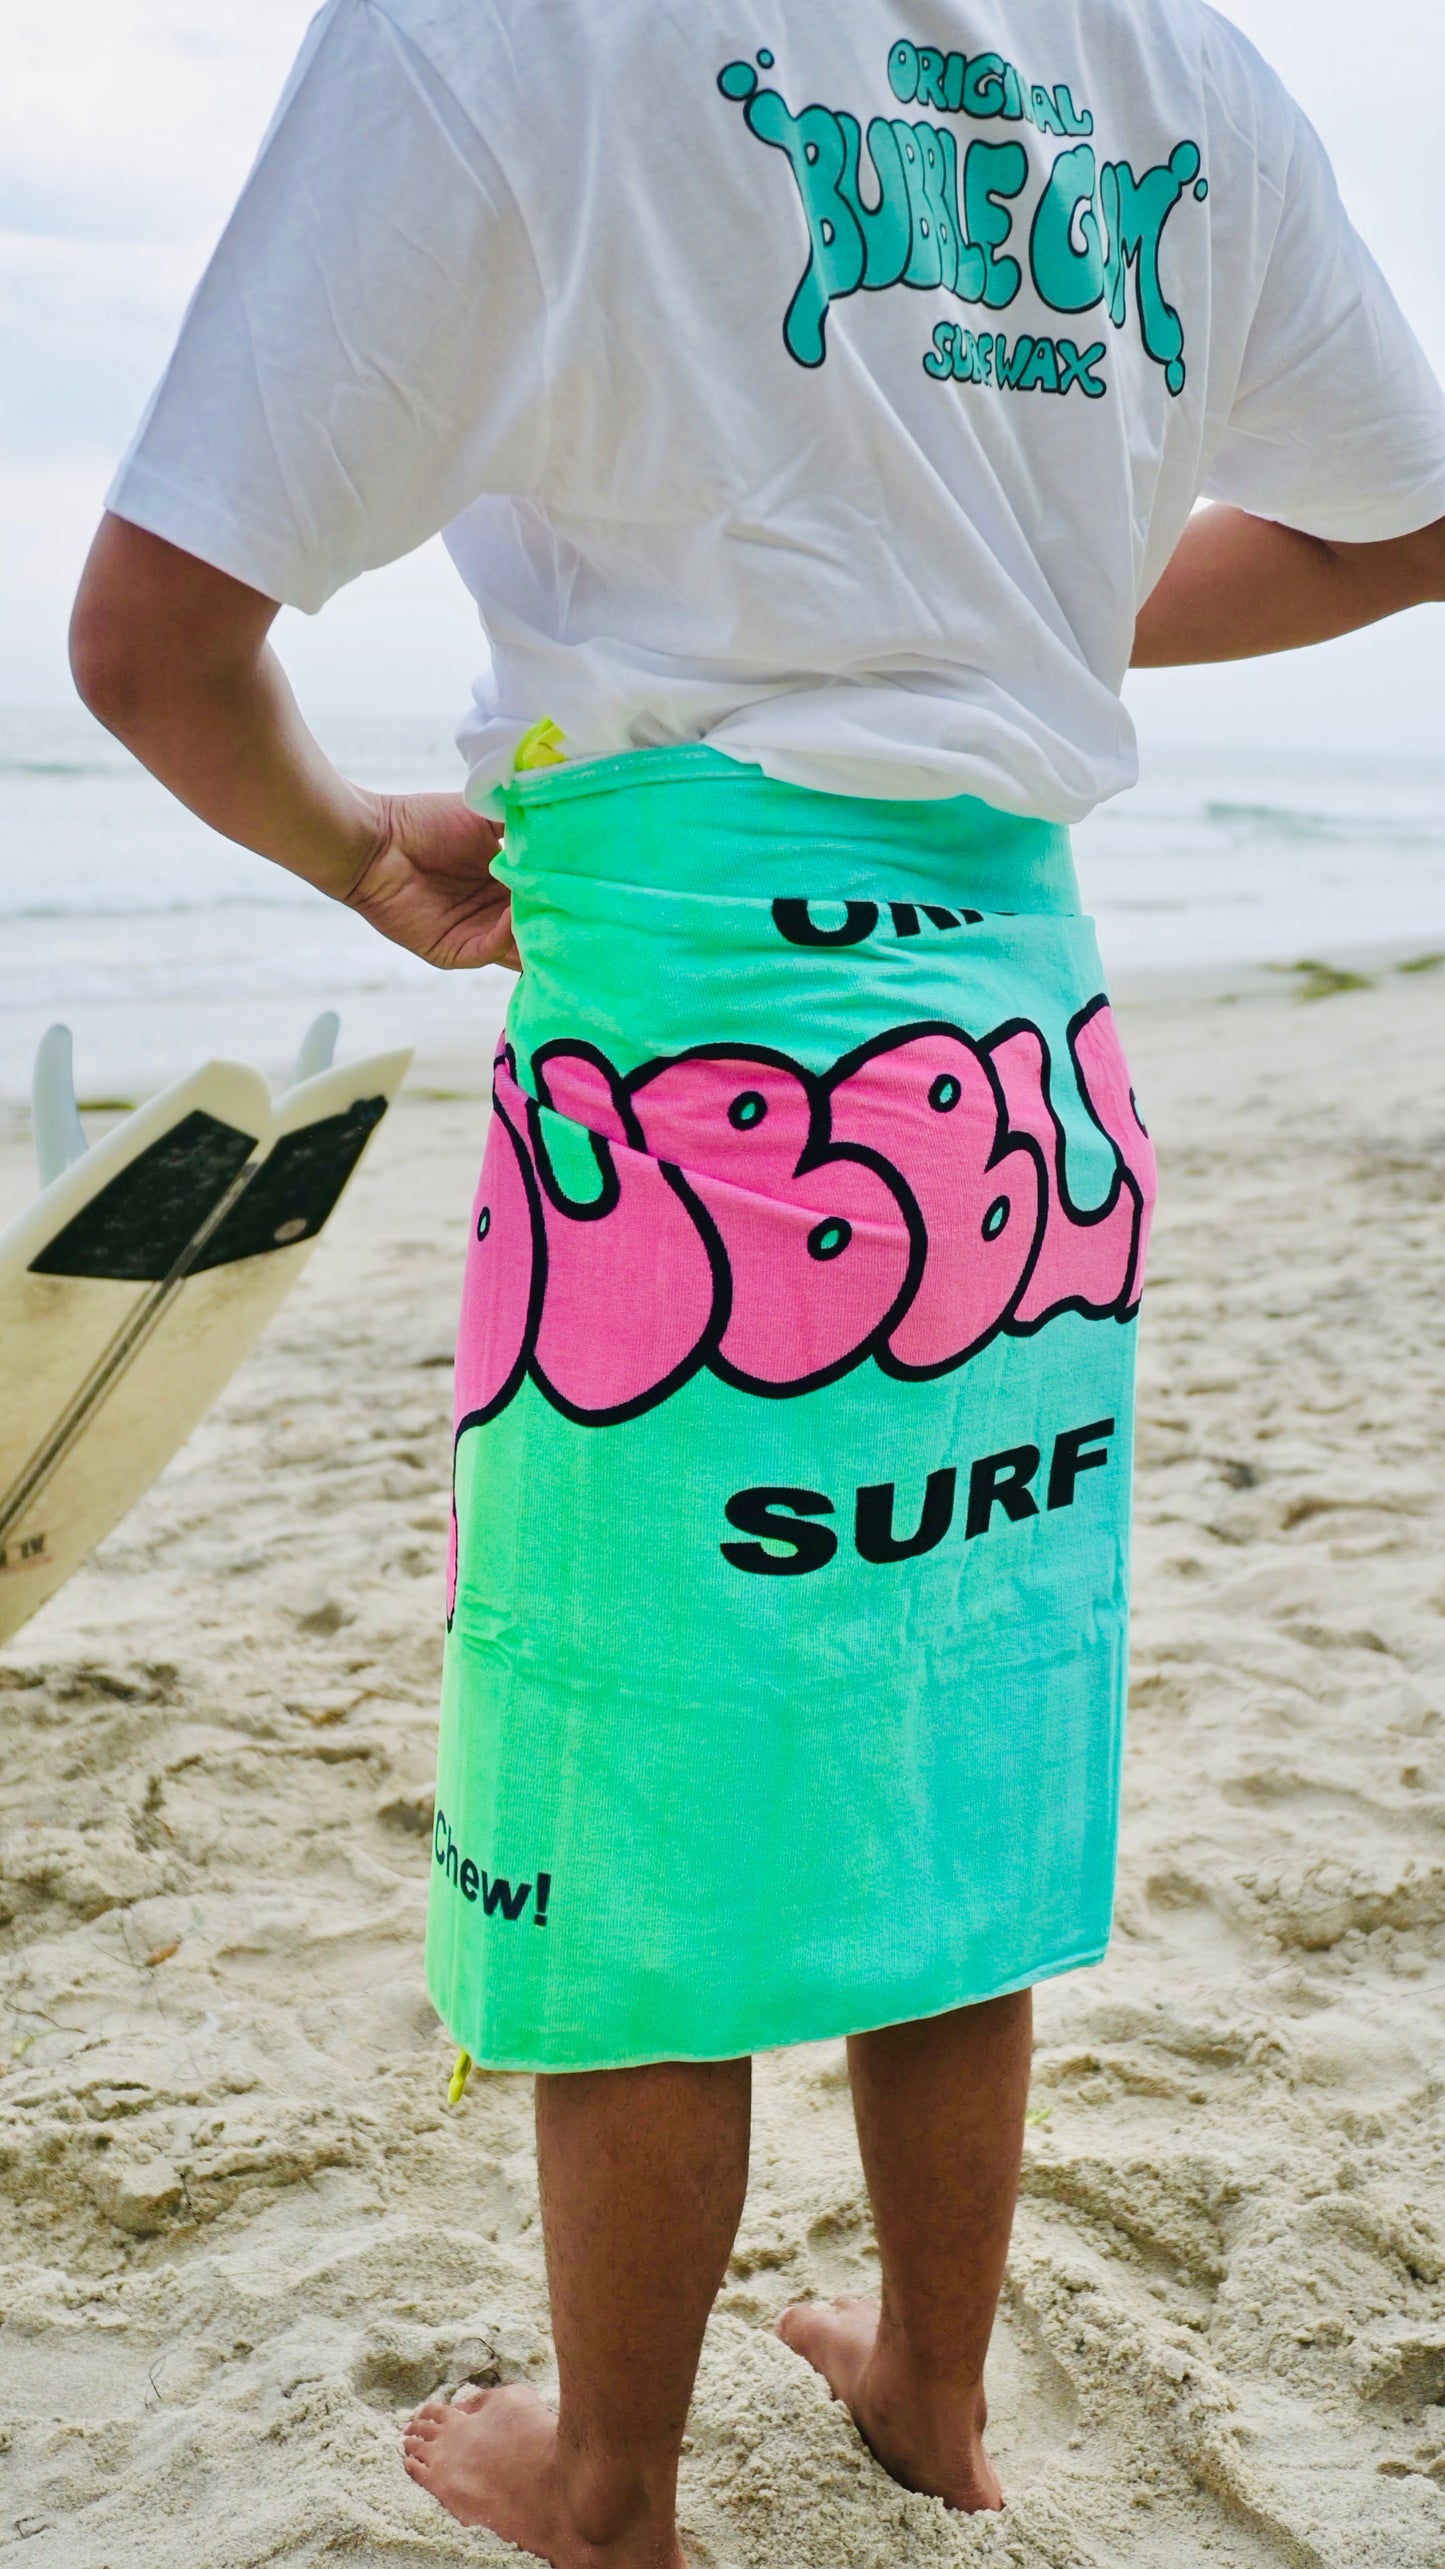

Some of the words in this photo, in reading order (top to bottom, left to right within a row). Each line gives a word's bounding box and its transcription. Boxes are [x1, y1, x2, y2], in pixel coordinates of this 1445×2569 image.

[743, 88, 1029, 368] BUBBLE
[996, 333, 1107, 398] WAX
[720, 1418, 1115, 1576] SURF
[434, 1809, 552, 1927] Chew!
